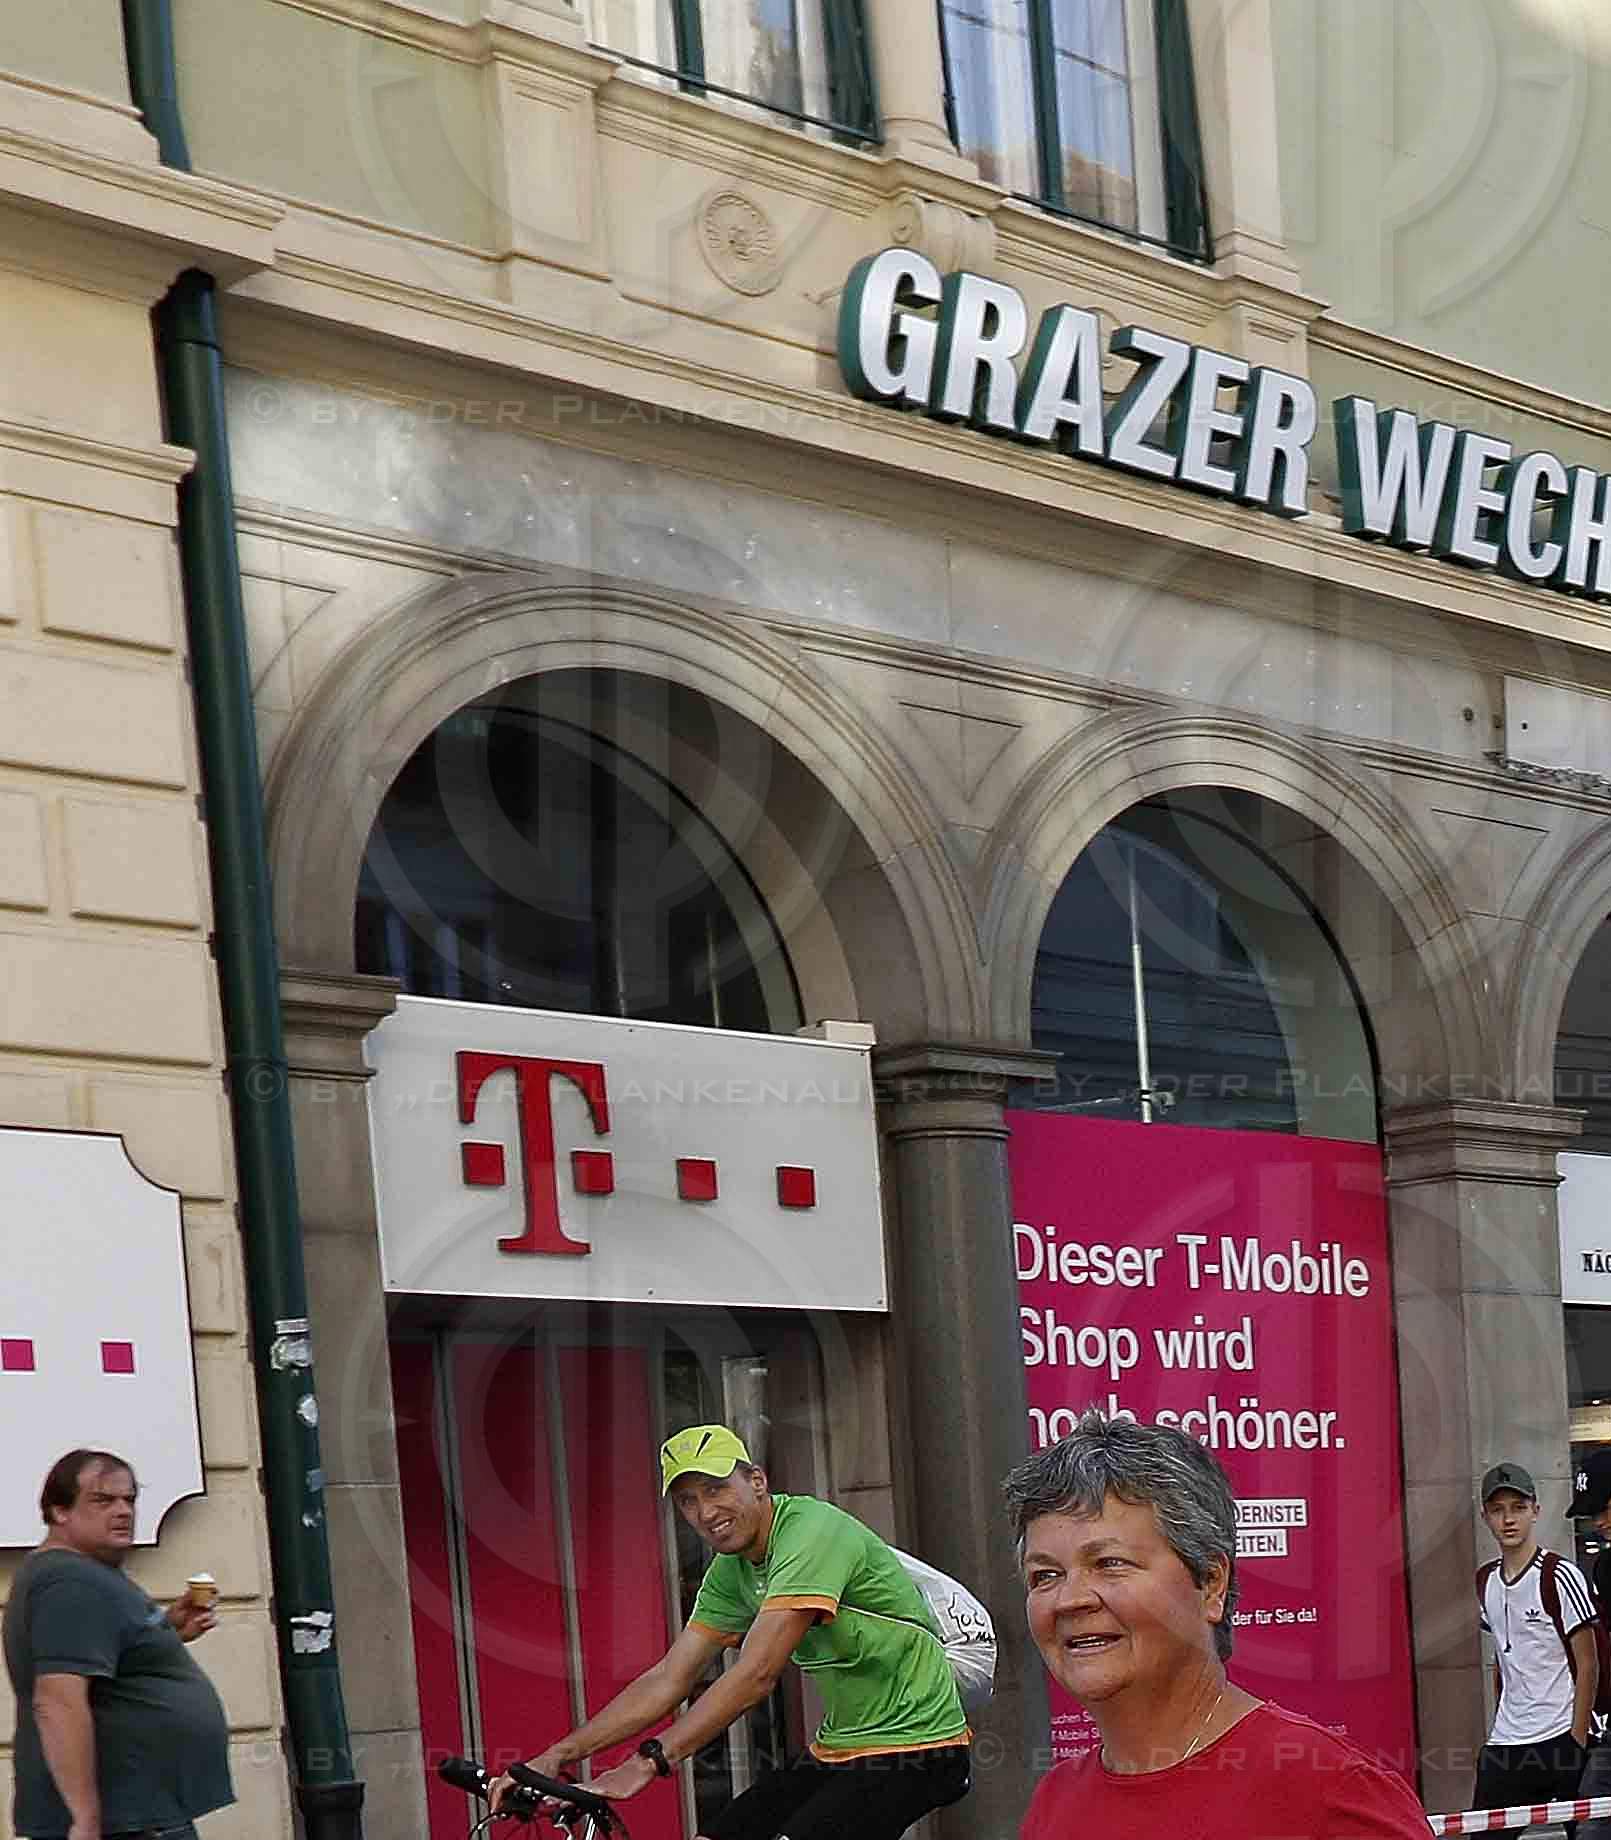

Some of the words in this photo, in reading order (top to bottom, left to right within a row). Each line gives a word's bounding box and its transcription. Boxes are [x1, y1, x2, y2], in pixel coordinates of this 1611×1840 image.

[848, 248, 1317, 516] GRAZER
[1012, 1224, 1162, 1287] Dieser
[1177, 1234, 1369, 1296] T-Mobile
[1020, 1307, 1138, 1380] Shop
[1154, 1315, 1254, 1370] wird
[1255, 1609, 1273, 1624] für
[1275, 1608, 1295, 1623] Sie
[1297, 1607, 1317, 1622] da!
